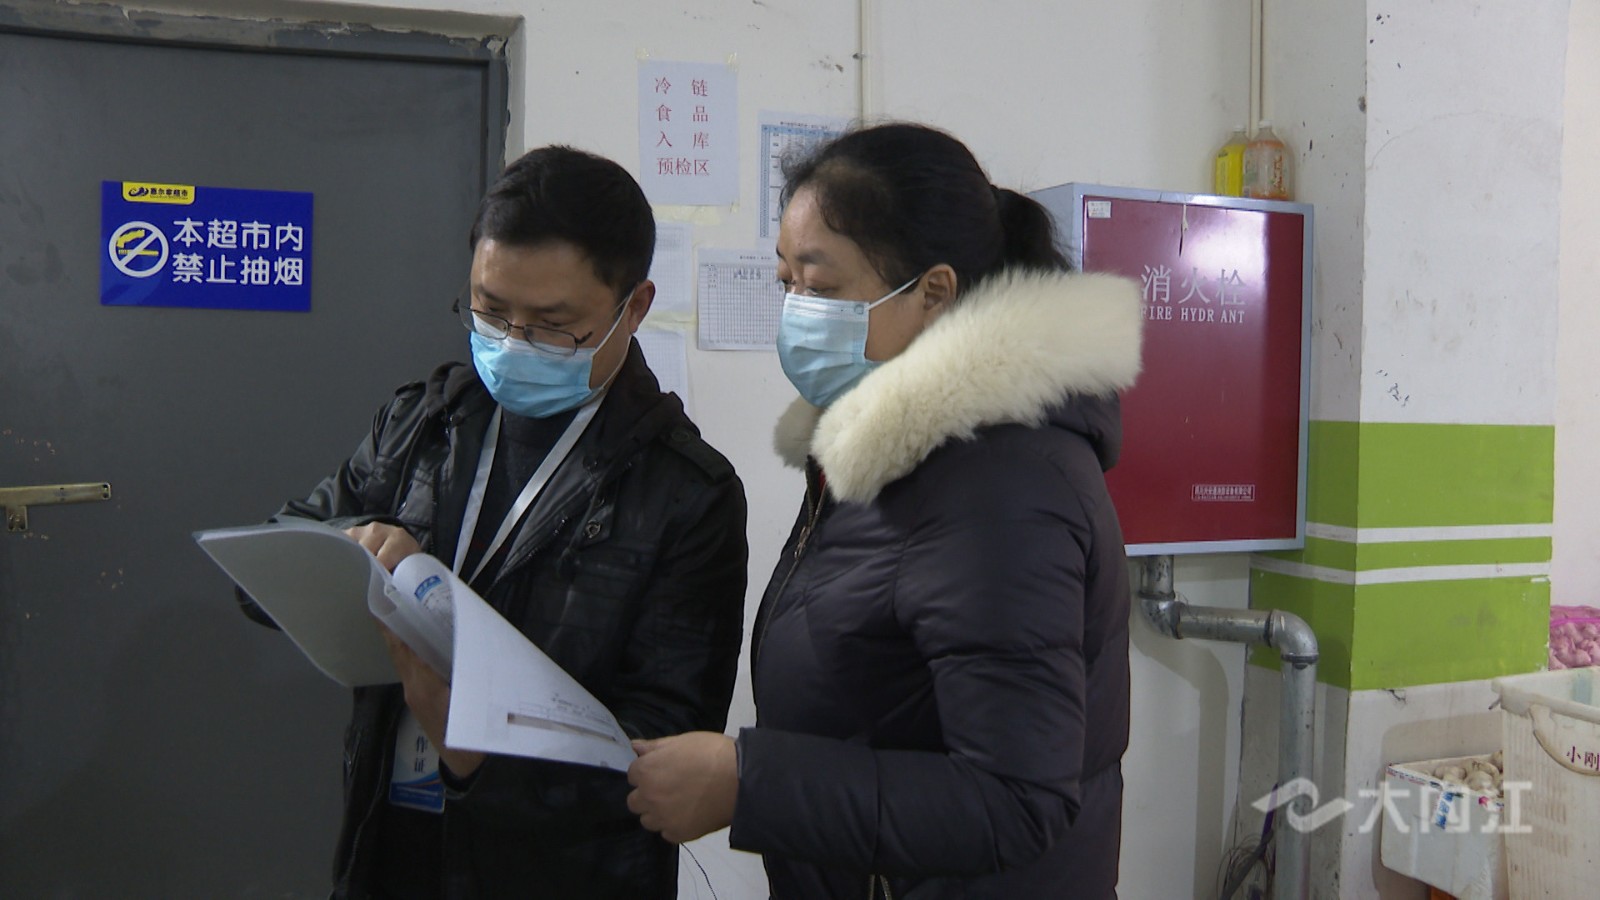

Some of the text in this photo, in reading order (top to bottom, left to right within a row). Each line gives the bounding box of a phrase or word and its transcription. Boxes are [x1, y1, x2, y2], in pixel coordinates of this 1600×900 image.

[655, 76, 709, 97] 冷链
[656, 104, 709, 123] 食品
[656, 131, 710, 150] 入库
[656, 157, 710, 176] 预检区
[172, 217, 304, 252] 本超市内
[172, 252, 304, 286] 禁止抽烟
[1140, 264, 1247, 306] 消火栓
[1140, 305, 1172, 321] FIRE
[1566, 746, 1600, 771] 小刚
